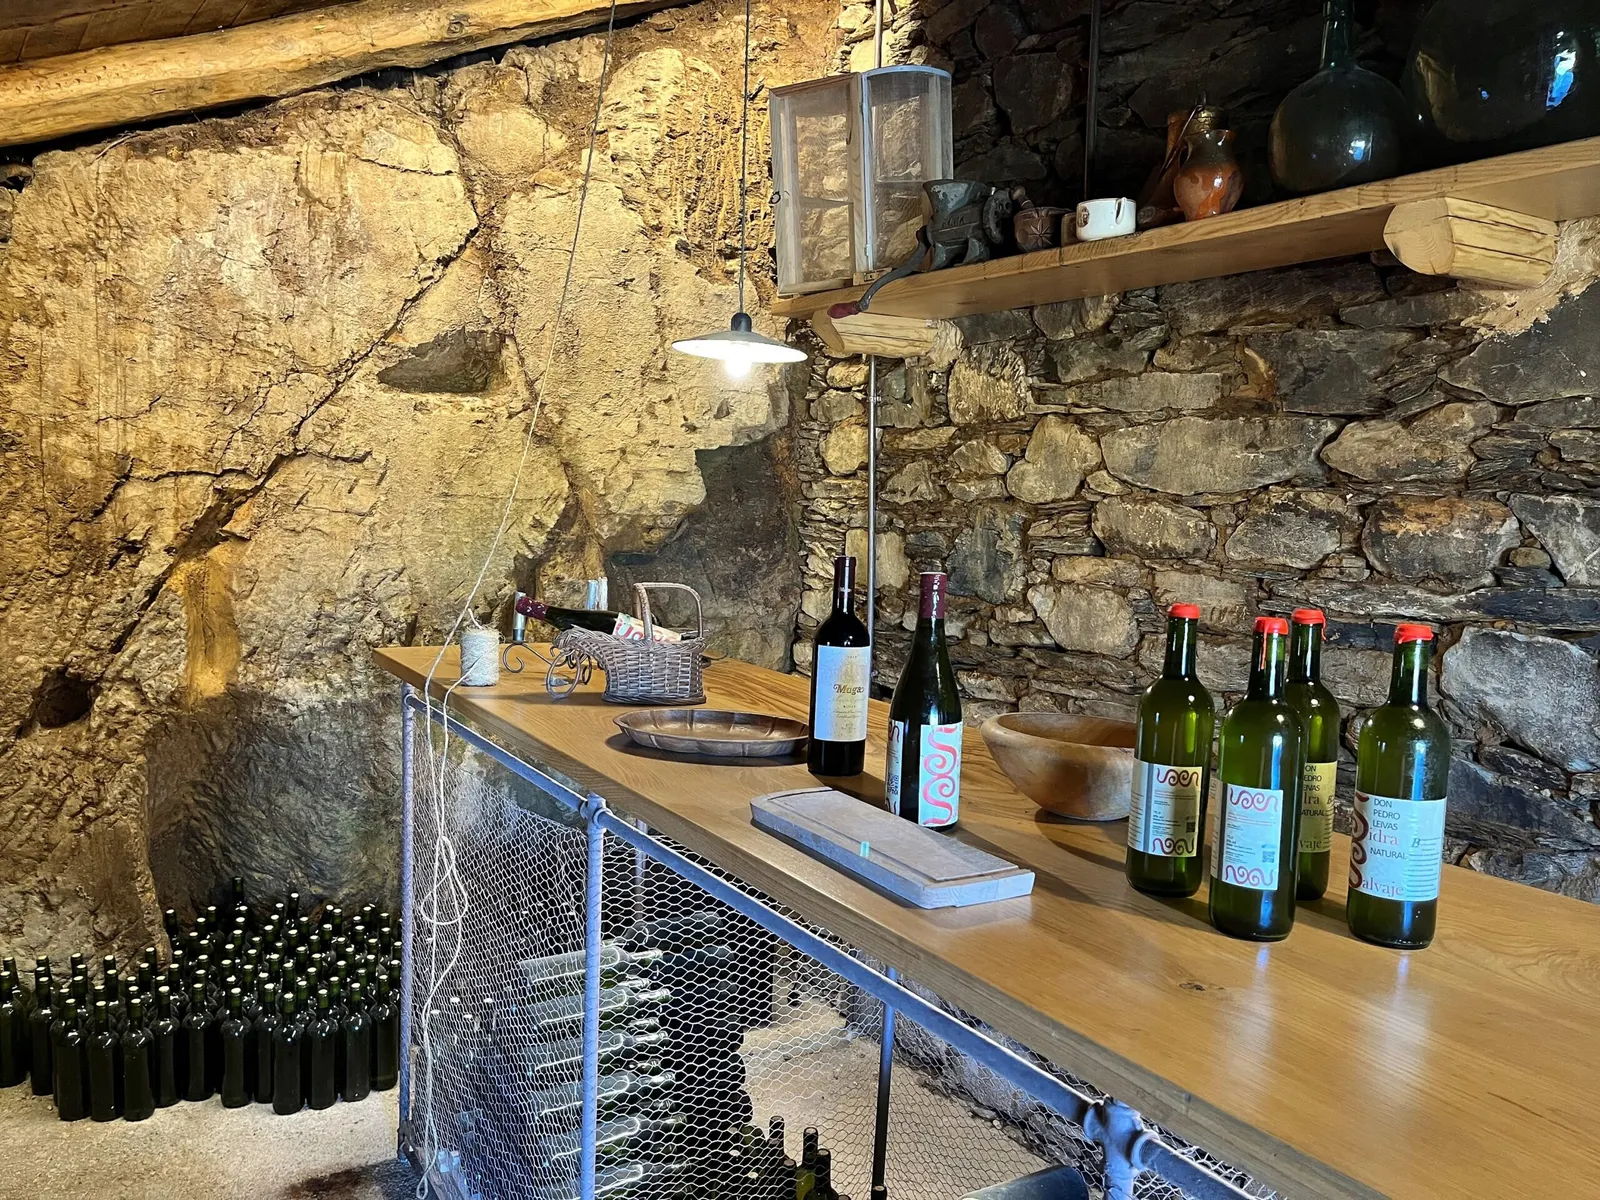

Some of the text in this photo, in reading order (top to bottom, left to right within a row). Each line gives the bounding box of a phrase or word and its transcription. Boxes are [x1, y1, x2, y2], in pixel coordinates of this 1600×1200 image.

[1374, 798, 1392, 808] DON
[1301, 809, 1325, 817] ATURAL
[1373, 809, 1400, 820] PEDRO
[1372, 820, 1398, 831] LEIVAS
[1370, 847, 1408, 860] NATURAL
